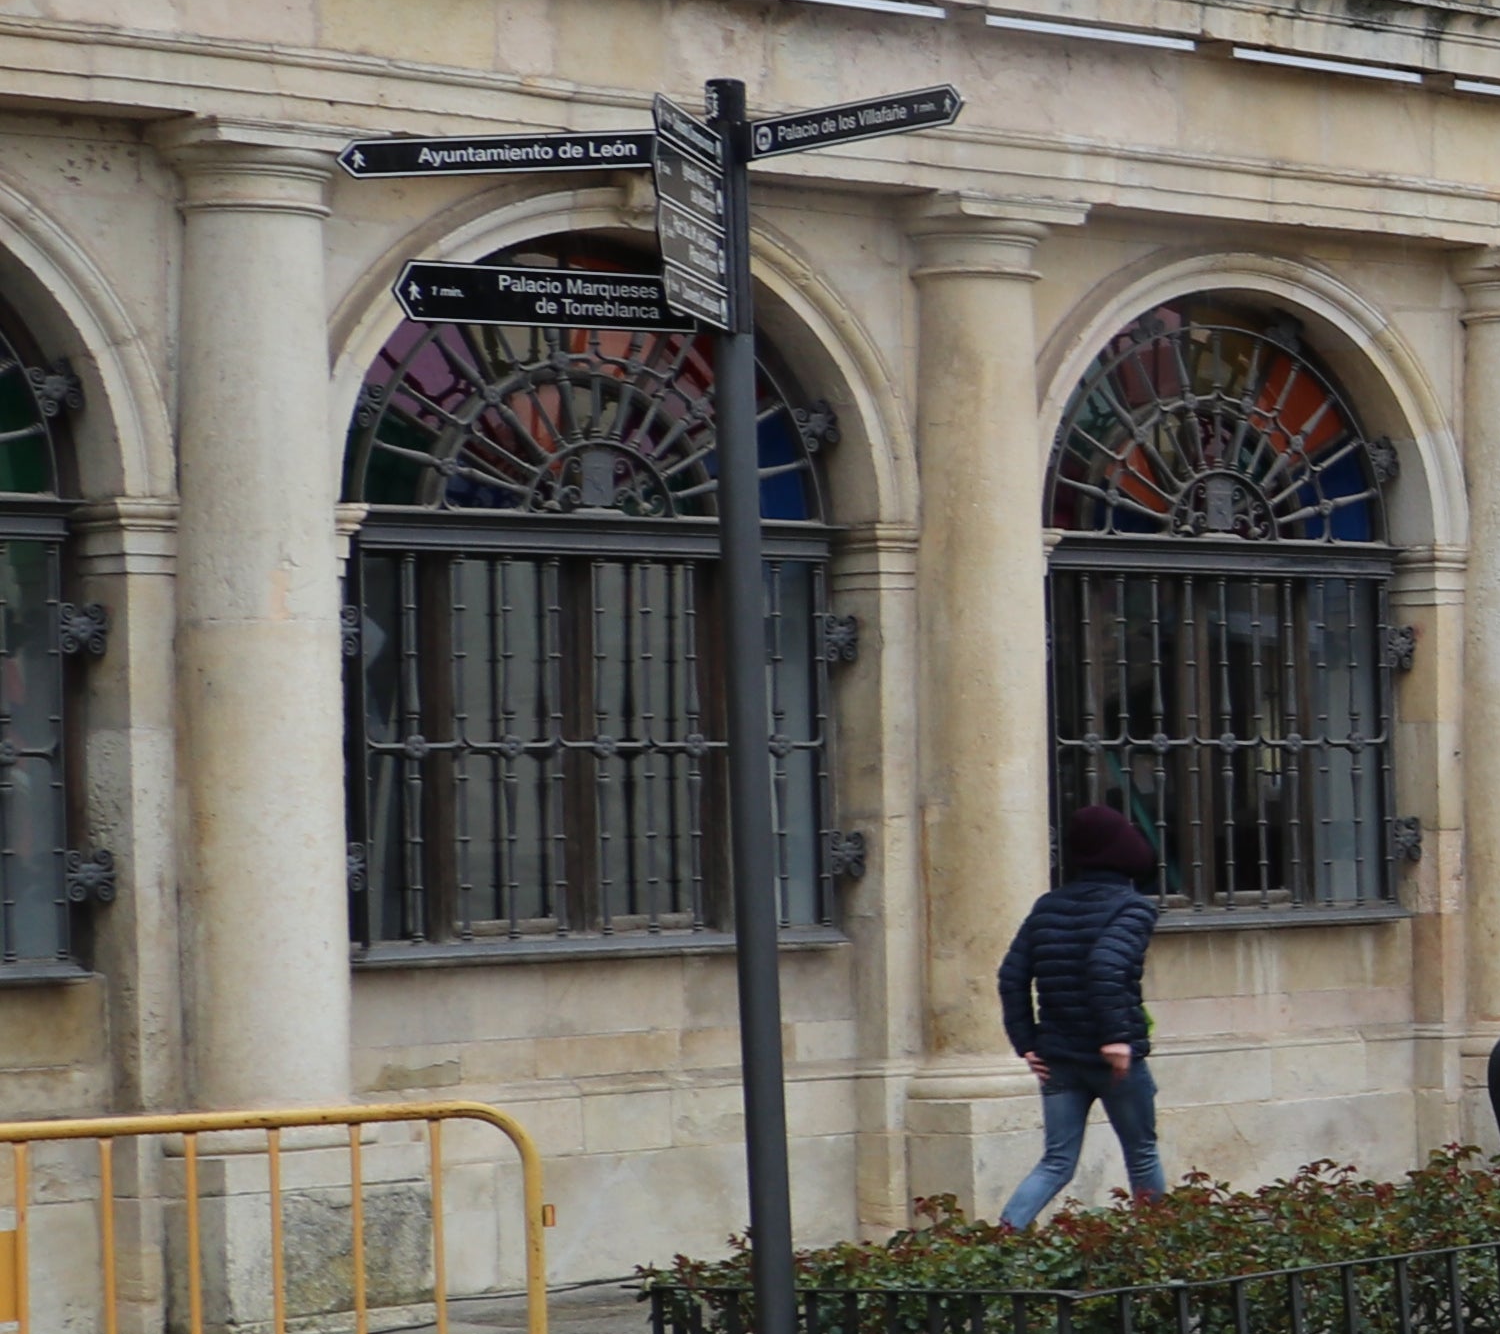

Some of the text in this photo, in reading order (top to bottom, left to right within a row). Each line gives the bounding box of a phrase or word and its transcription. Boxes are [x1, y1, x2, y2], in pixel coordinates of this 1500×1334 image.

[777, 120, 818, 142] Palacio
[821, 119, 837, 135] de
[838, 114, 856, 131] los
[857, 104, 908, 127] Villafañe
[418, 139, 638, 167] Ayuntamiento de León
[440, 286, 464, 298] min.
[498, 274, 562, 295] Palacio
[566, 277, 659, 299] Marqueses
[535, 297, 558, 314] de
[561, 298, 660, 319] Torreblanca
